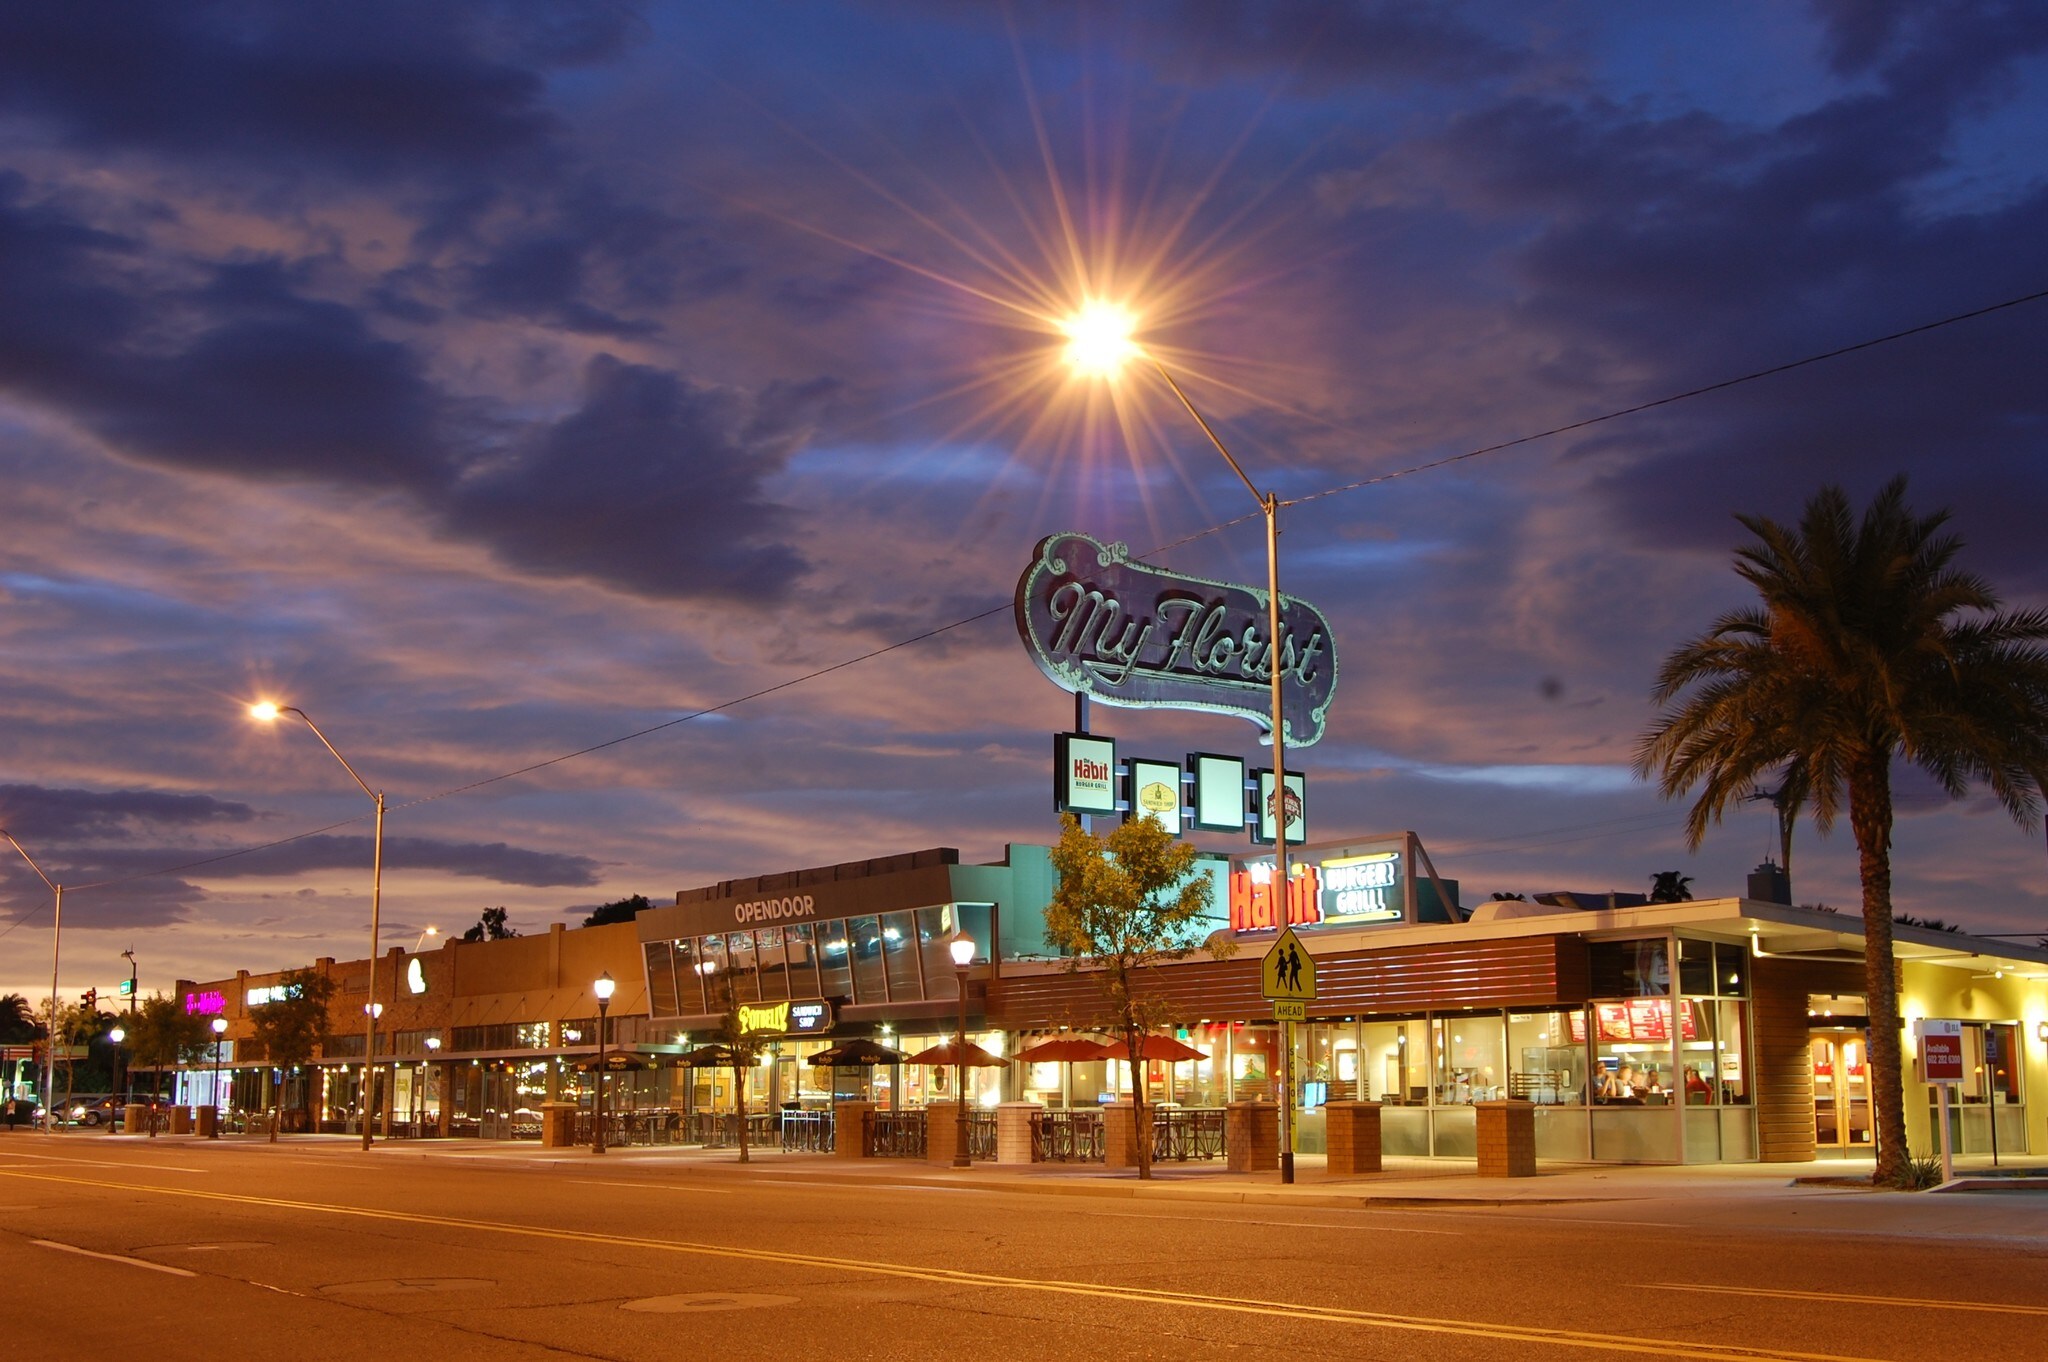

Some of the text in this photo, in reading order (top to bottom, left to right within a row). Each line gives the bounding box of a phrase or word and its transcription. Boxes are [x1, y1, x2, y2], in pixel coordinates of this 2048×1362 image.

[1050, 581, 1322, 687] My Florist
[1074, 758, 1108, 781] Habit
[1326, 862, 1394, 891] BURGER
[735, 895, 815, 923] OPENDOOR
[1231, 861, 1318, 931] Habit
[1336, 887, 1386, 915] GRILL
[1277, 1006, 1302, 1016] AHEAD
[1927, 1044, 1949, 1053] Available
[1927, 1055, 1937, 1064] 602
